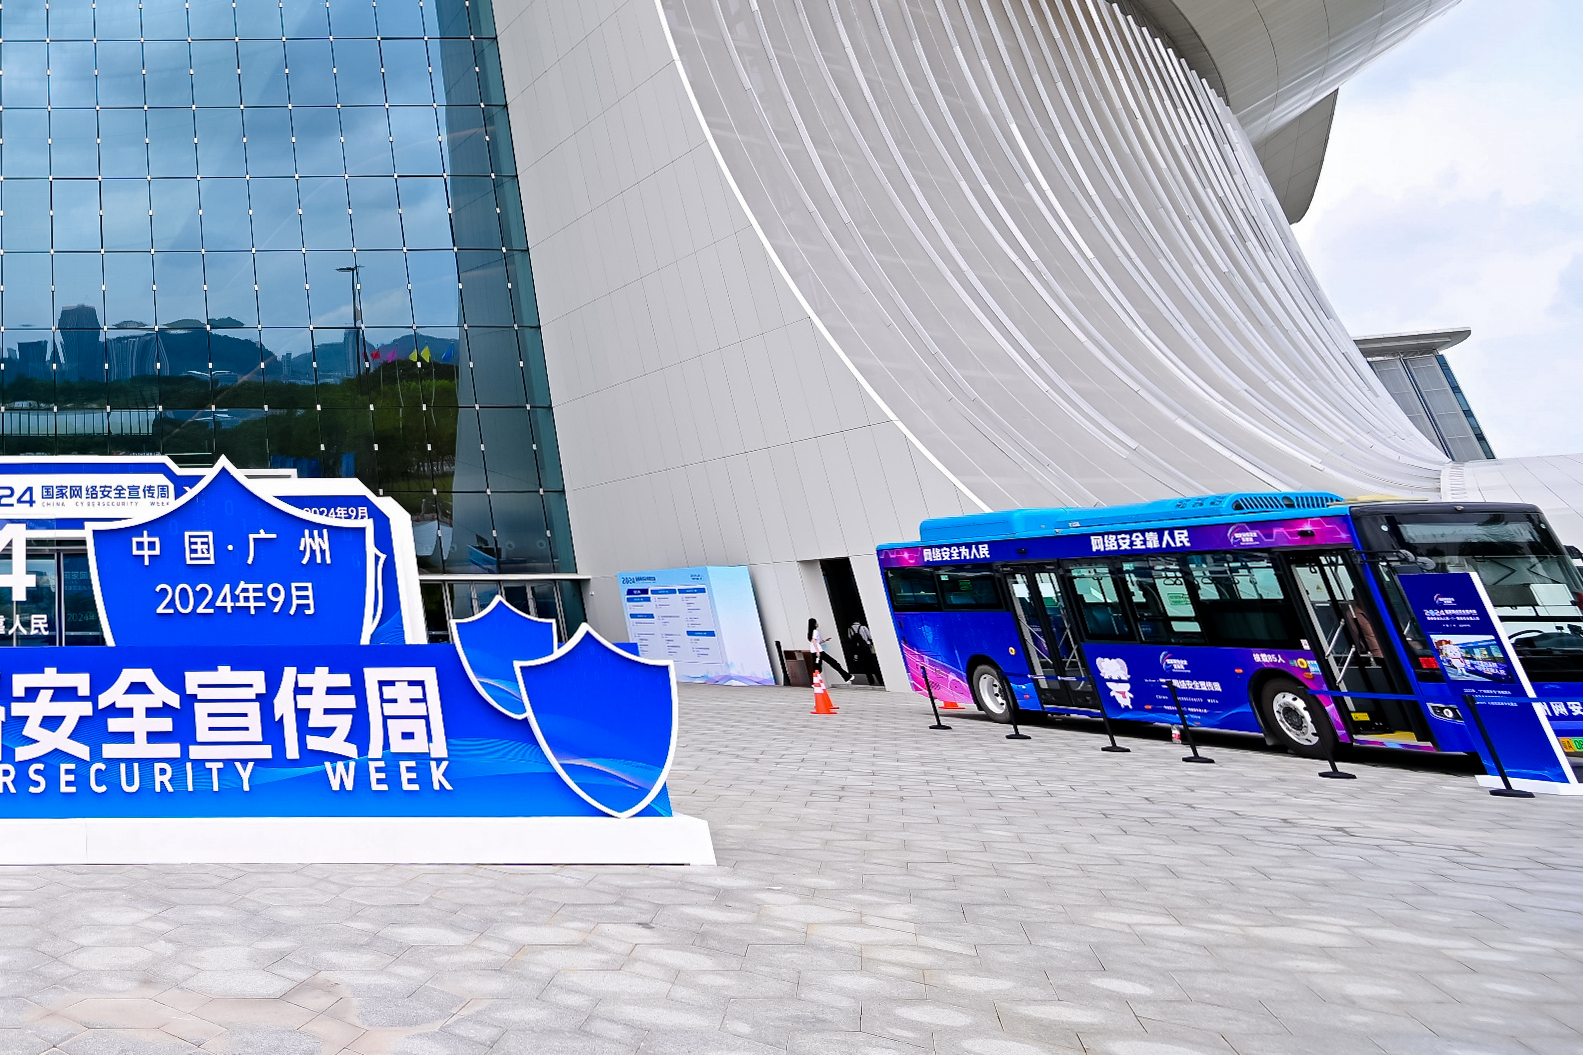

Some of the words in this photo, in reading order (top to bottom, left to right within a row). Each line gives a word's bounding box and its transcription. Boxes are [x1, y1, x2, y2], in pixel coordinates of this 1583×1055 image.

[41, 485, 170, 499] 国家网络安全宣传周
[131, 528, 332, 566] 中国·广州
[923, 544, 990, 562] 网络安全为人民
[1090, 529, 1191, 552] 网络安全靠人民
[155, 581, 315, 615] 2024年9月
[324, 760, 454, 791] WEEK
